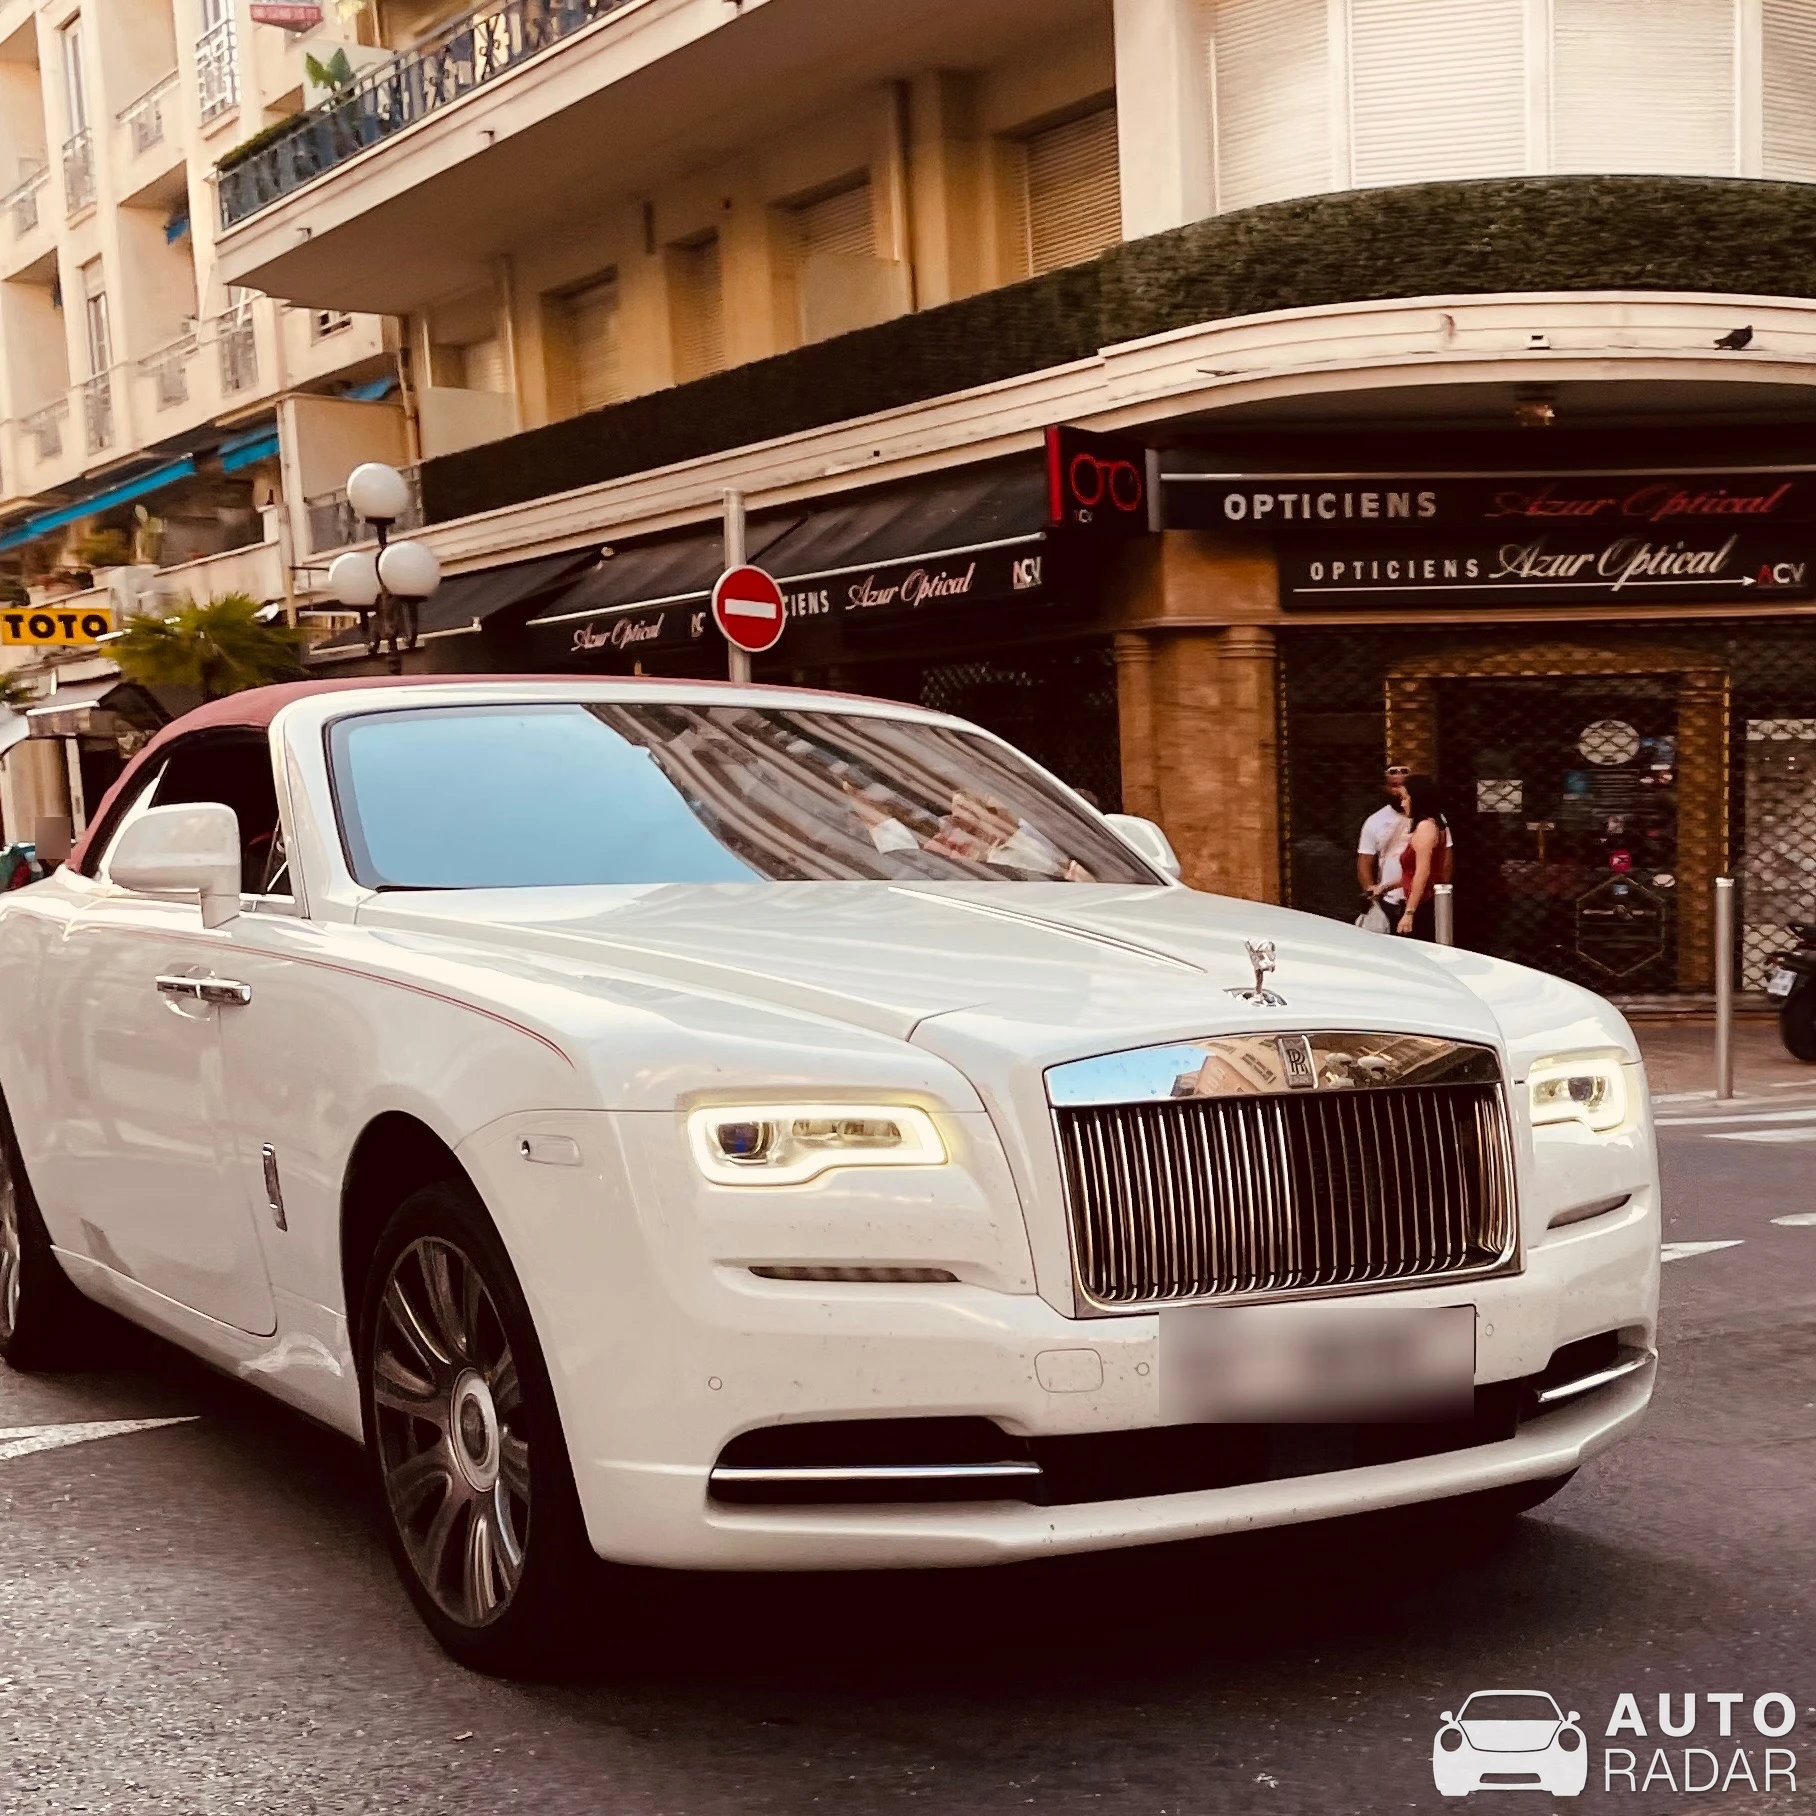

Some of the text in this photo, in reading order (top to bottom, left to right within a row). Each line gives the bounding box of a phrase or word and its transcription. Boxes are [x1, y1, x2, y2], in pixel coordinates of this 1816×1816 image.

[1223, 491, 1437, 521] OPTICIENS
[1309, 533, 1806, 591] OPTICIENS Azur Optical ACV
[845, 575, 899, 610] Azur
[901, 562, 976, 607] Optical
[4, 614, 109, 639] TOTO
